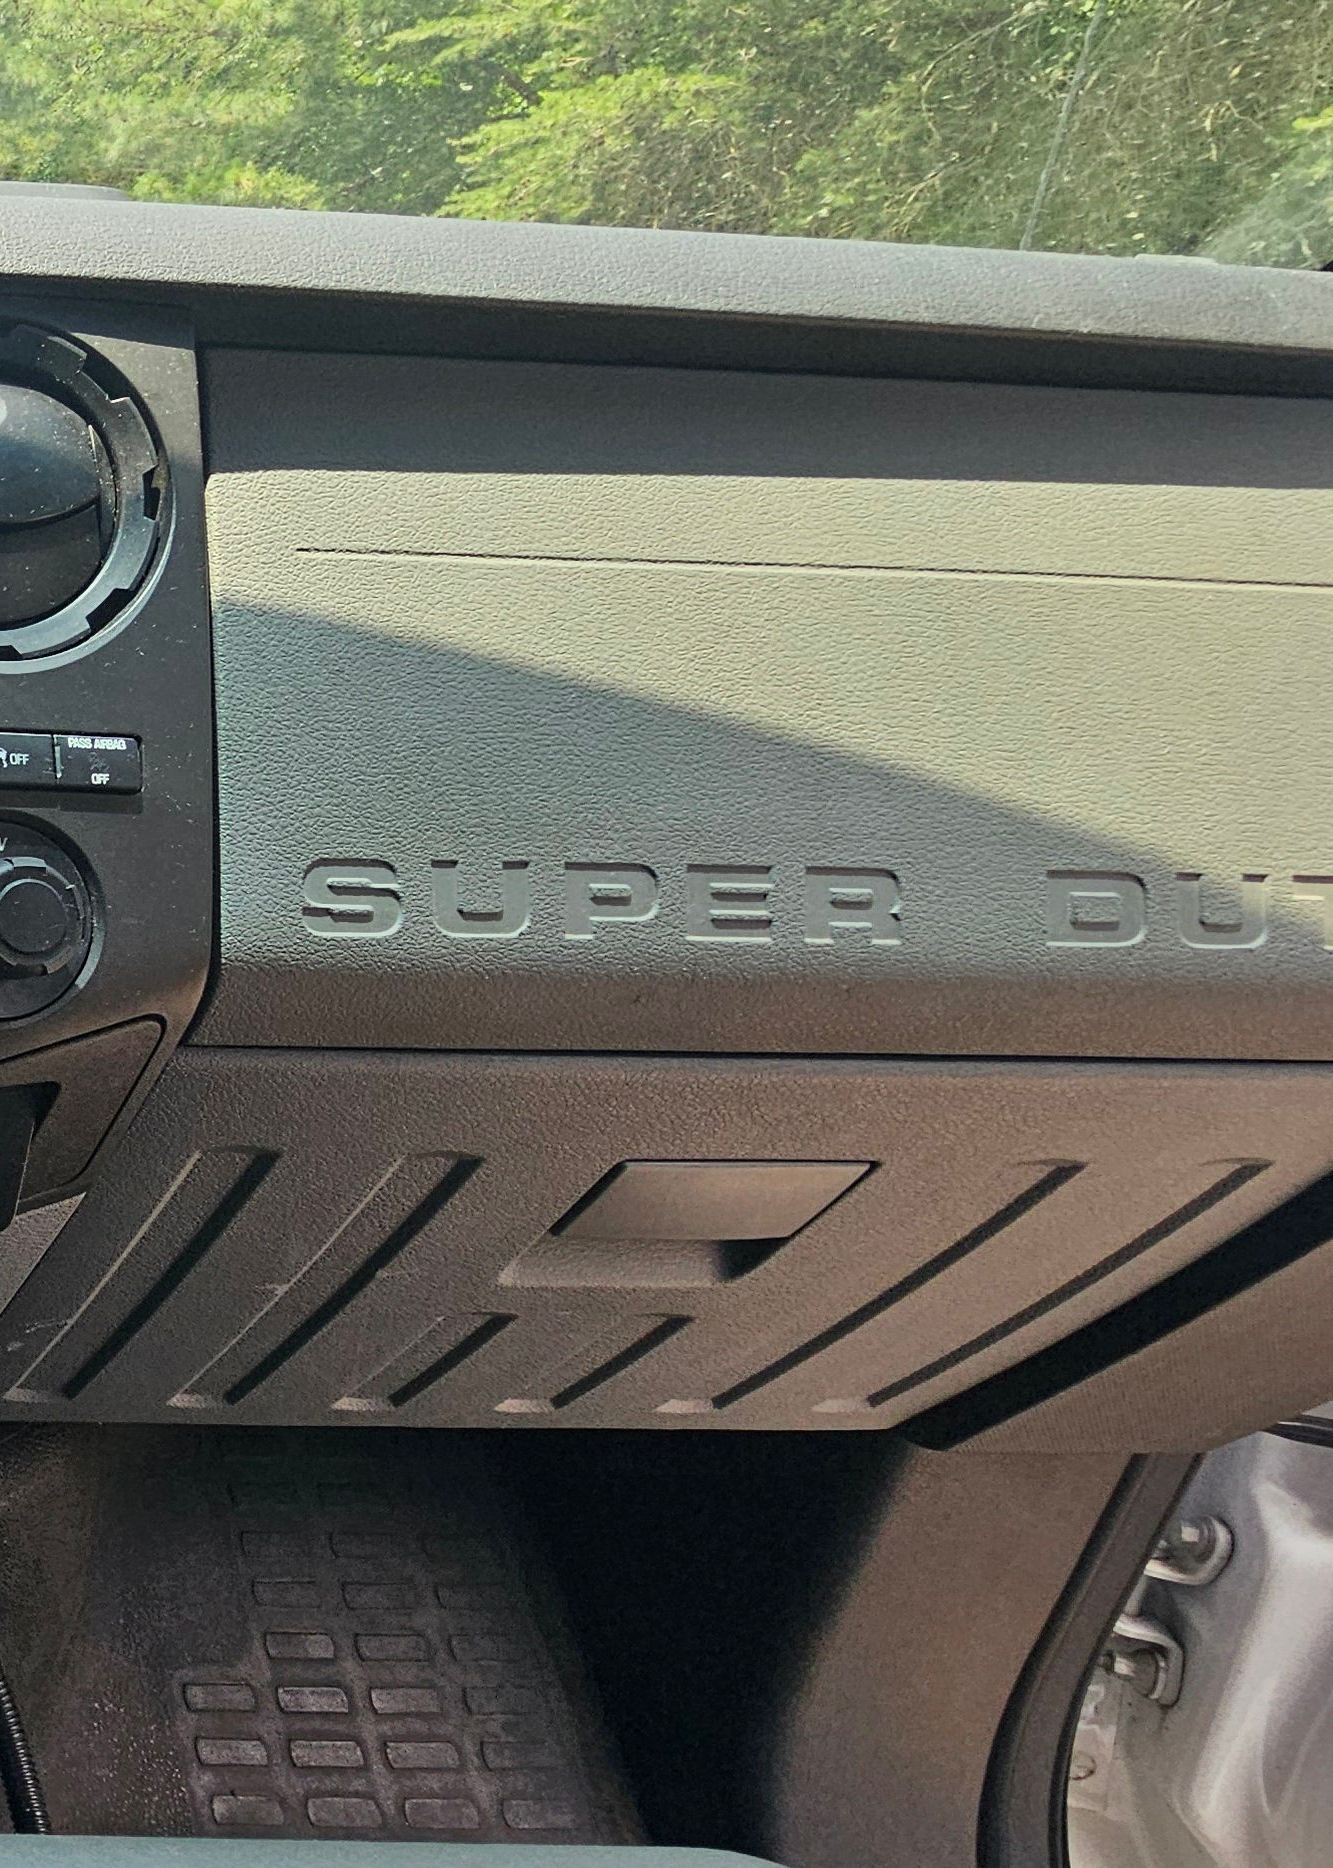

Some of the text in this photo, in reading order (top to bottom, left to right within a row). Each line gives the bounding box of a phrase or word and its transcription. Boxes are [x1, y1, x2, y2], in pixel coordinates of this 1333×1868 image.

[68, 737, 127, 750] PASS AIRBAG
[9, 753, 29, 765] OFF
[91, 773, 110, 785] OFF
[300, 857, 903, 946] SUPER
